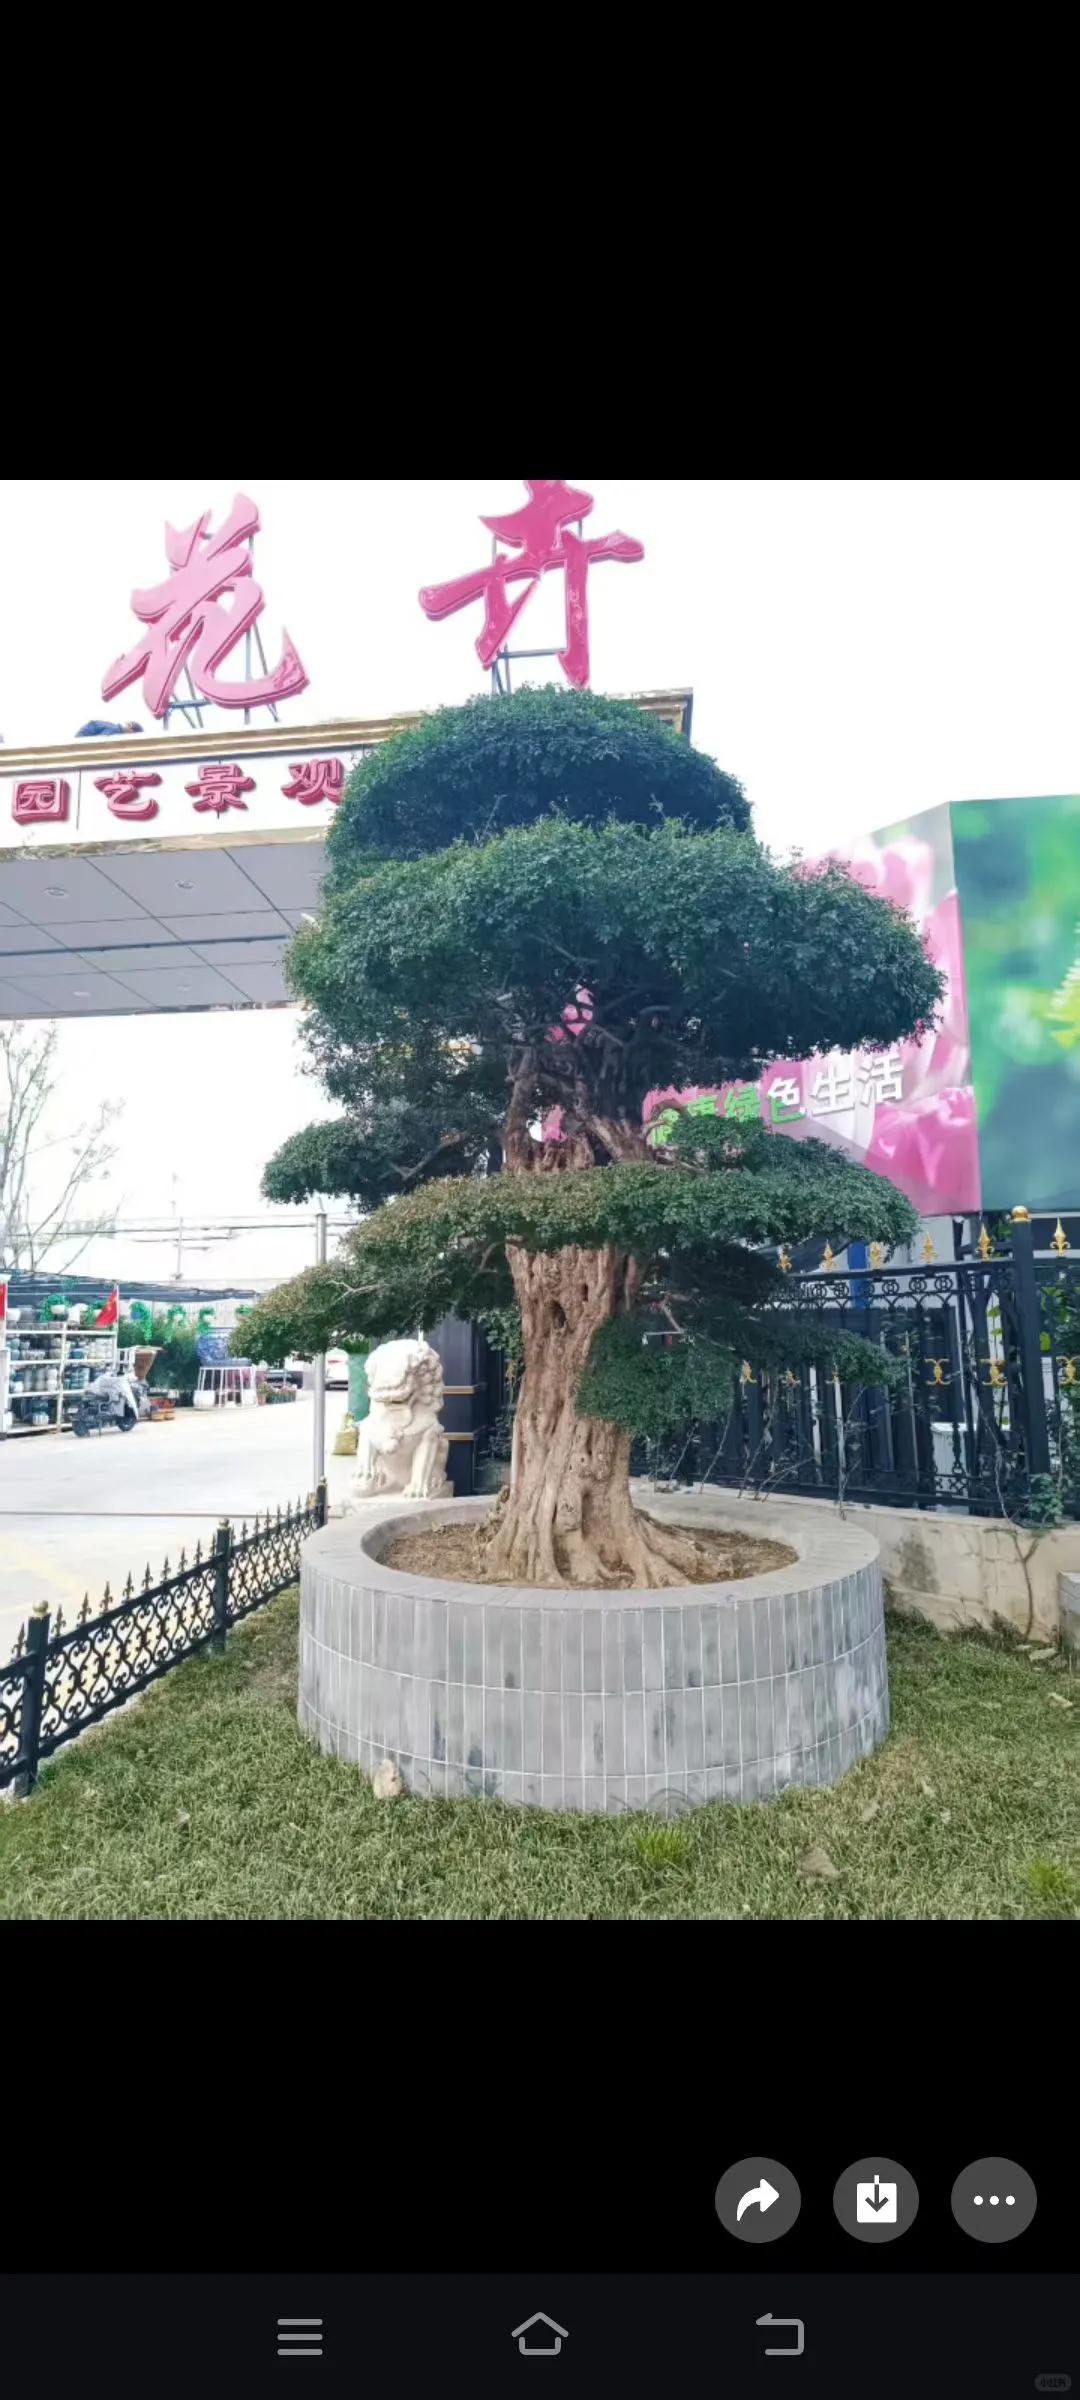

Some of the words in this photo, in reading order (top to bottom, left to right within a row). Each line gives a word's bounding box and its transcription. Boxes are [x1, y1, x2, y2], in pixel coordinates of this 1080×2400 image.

[101, 480, 644, 718] 花卉
[12, 758, 346, 825] 园艺景观
